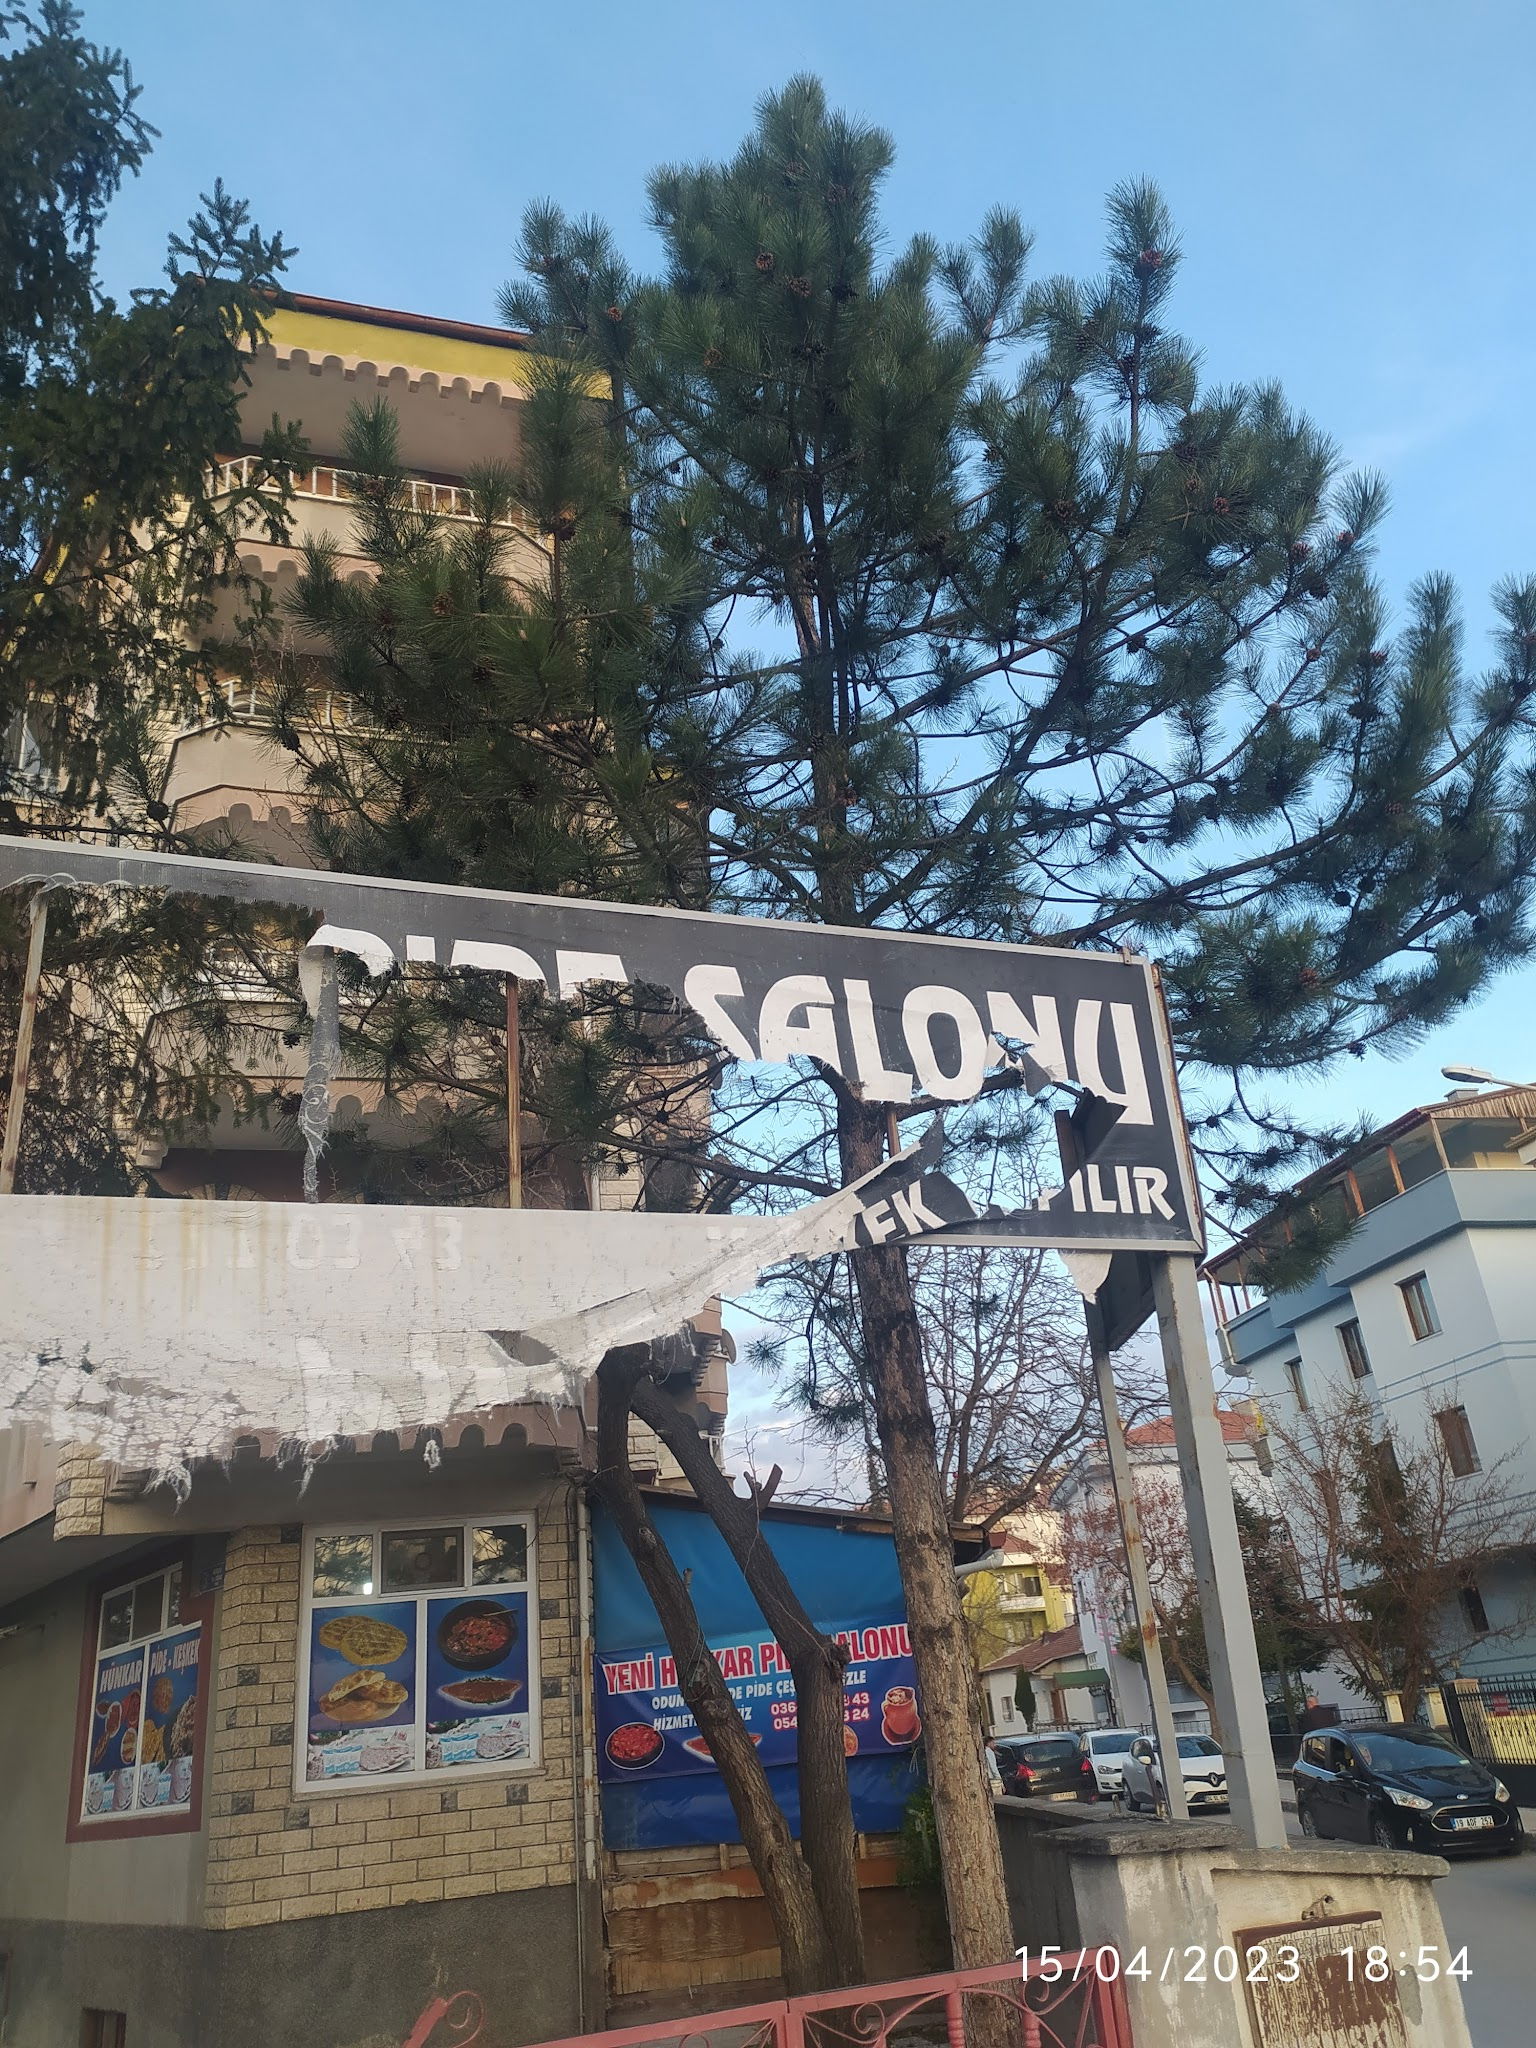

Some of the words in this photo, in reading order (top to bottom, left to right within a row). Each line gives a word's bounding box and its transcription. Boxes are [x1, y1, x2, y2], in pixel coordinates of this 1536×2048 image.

[100, 1660, 143, 1693] HÜNKAR
[150, 1645, 168, 1676] PİDE
[602, 1652, 655, 1695] YENİ
[831, 1623, 913, 1664] ALONU
[746, 1680, 773, 1699] PİDE
[771, 1701, 798, 1716] 036
